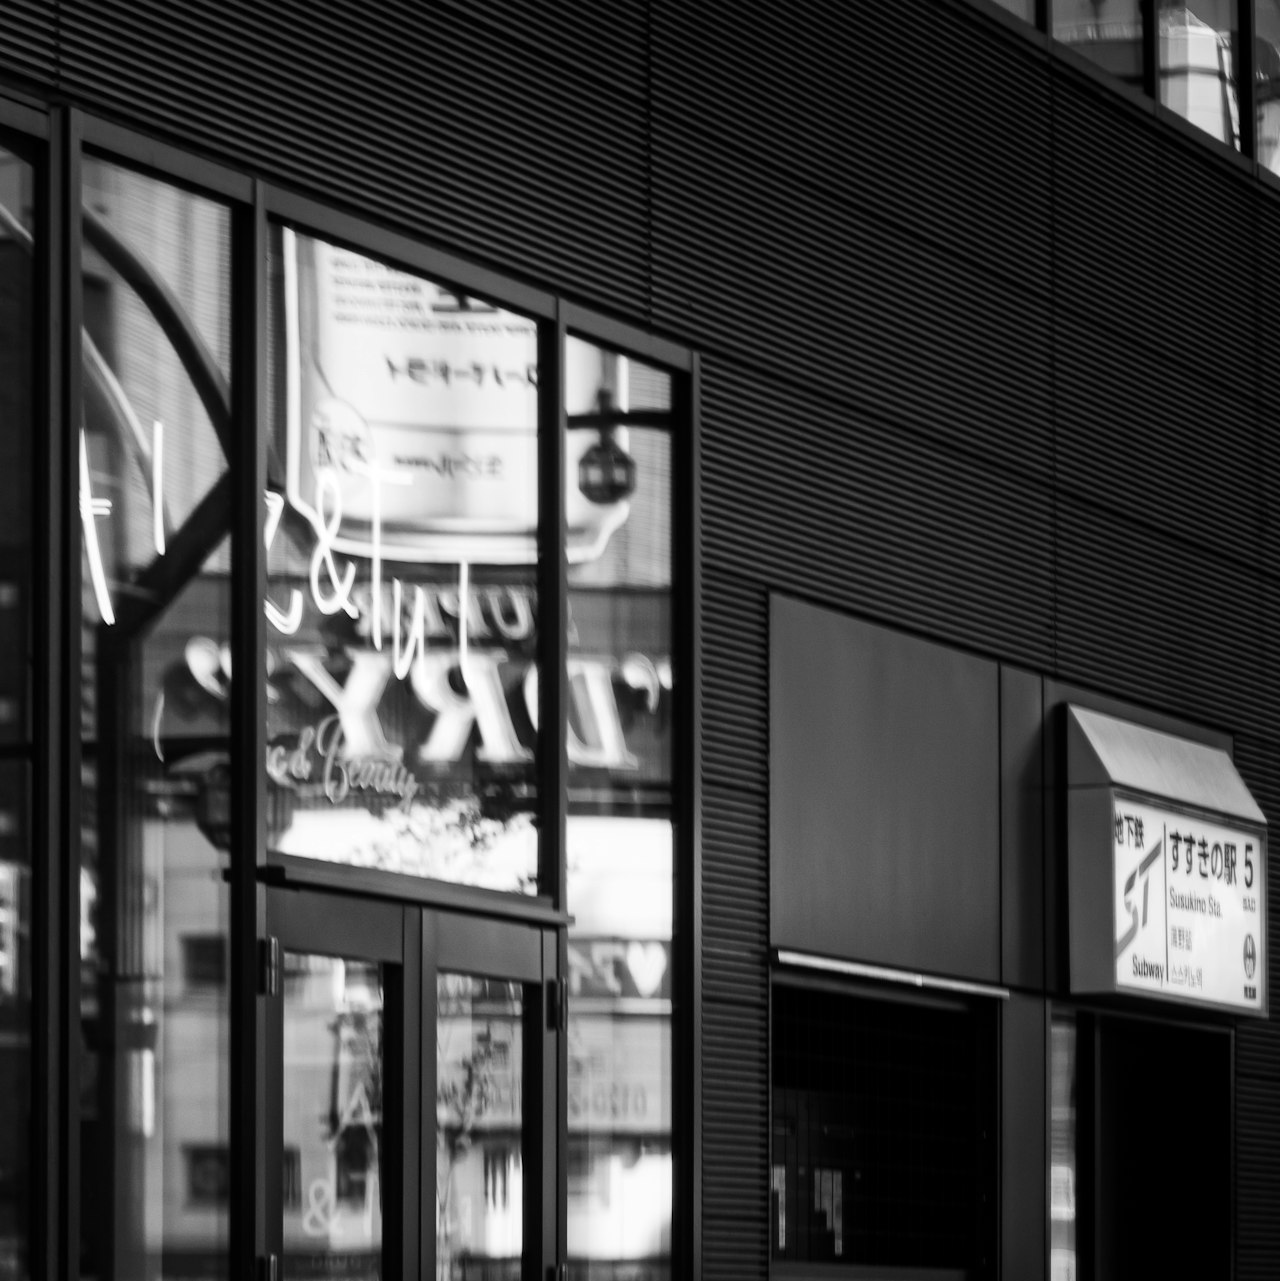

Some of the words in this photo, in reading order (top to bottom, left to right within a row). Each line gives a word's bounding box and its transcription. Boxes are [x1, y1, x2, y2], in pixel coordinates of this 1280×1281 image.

[1114, 812, 1145, 849] 地下鉄
[1169, 830, 1237, 886] すすきの駅
[1244, 843, 1253, 888] 5
[1169, 886, 1206, 911] Susukino
[1208, 894, 1223, 919] Sta.
[1132, 953, 1165, 988] Subway
